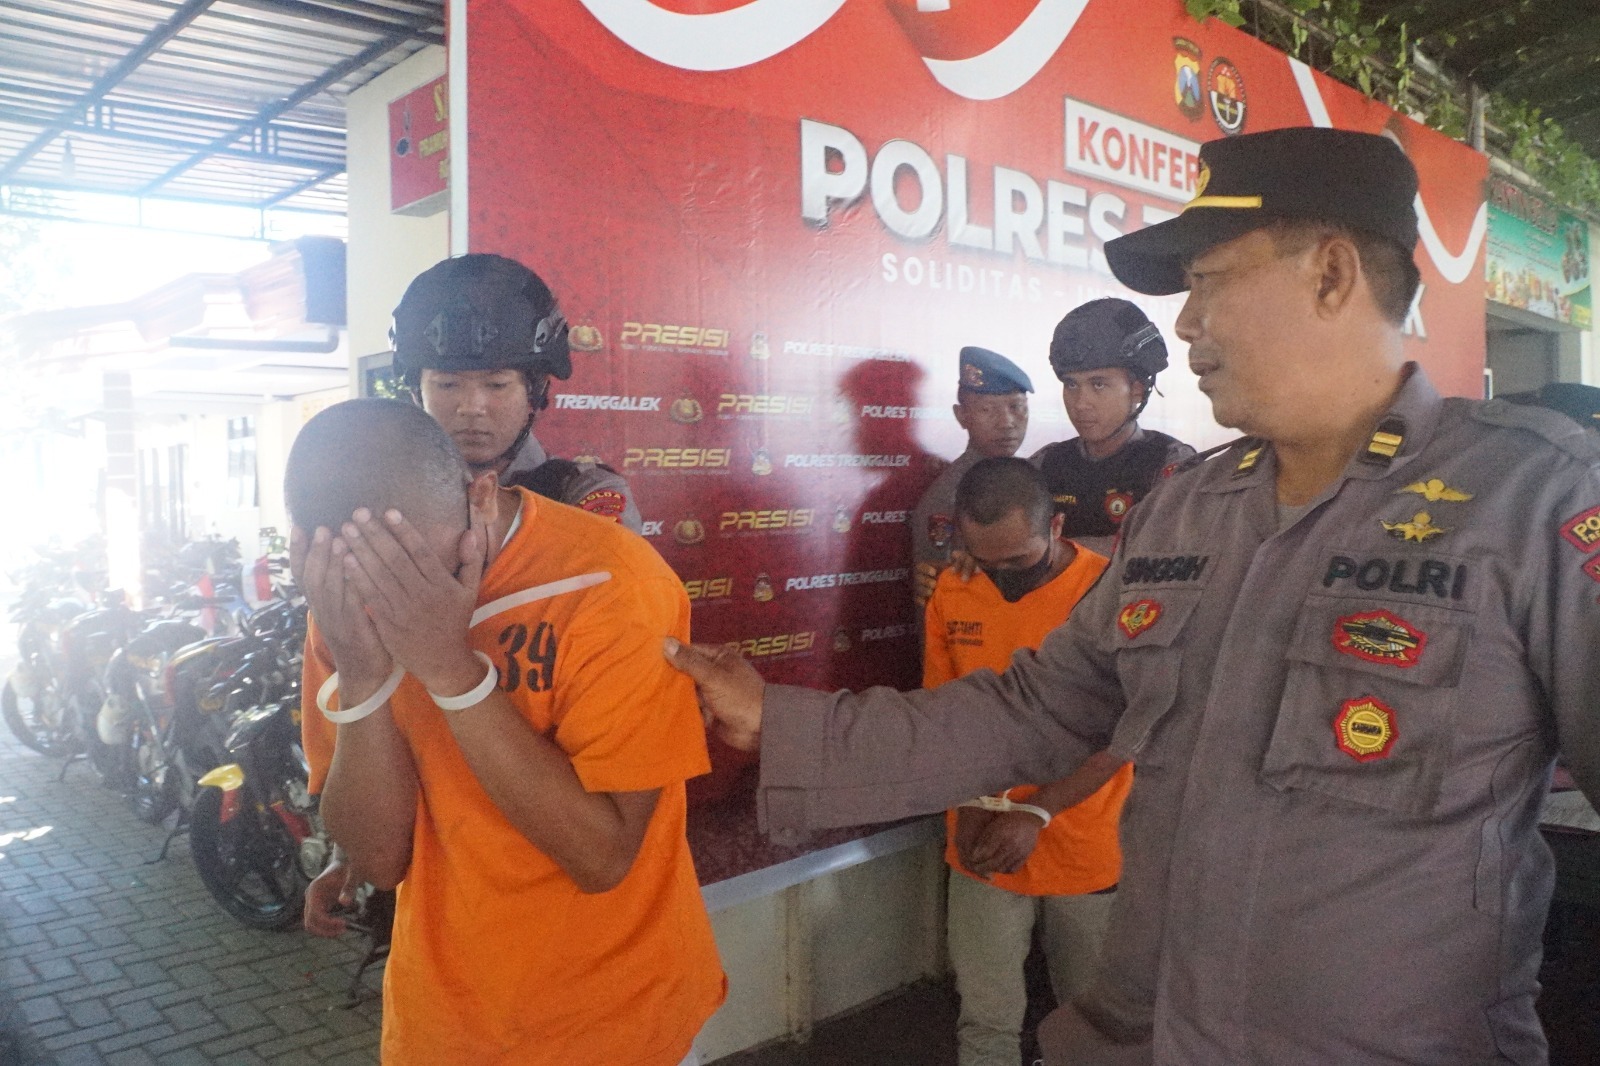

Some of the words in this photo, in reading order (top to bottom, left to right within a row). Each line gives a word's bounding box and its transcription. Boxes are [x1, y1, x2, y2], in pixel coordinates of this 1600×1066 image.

[1078, 117, 1199, 192] KONFER
[800, 117, 1127, 276] POLRES
[881, 252, 1042, 302] SOLIDITAS
[621, 322, 729, 348] PRESISI
[783, 340, 834, 356] POLRES
[555, 394, 661, 412] TRENGGALEK
[716, 394, 813, 414] PRESISI
[861, 405, 907, 419] POLRES
[622, 448, 731, 467] PRESISI
[784, 454, 836, 467] POLRES
[838, 454, 911, 467] TRENGGALEK
[720, 509, 815, 530] PRESISI
[861, 510, 907, 524] POLRES
[685, 577, 732, 600] SISI
[785, 574, 836, 592] POLRES
[837, 568, 911, 586] TRENGGALEK
[1323, 555, 1468, 601] POLRI
[862, 624, 906, 641] POLRES
[498, 621, 557, 693] 39
